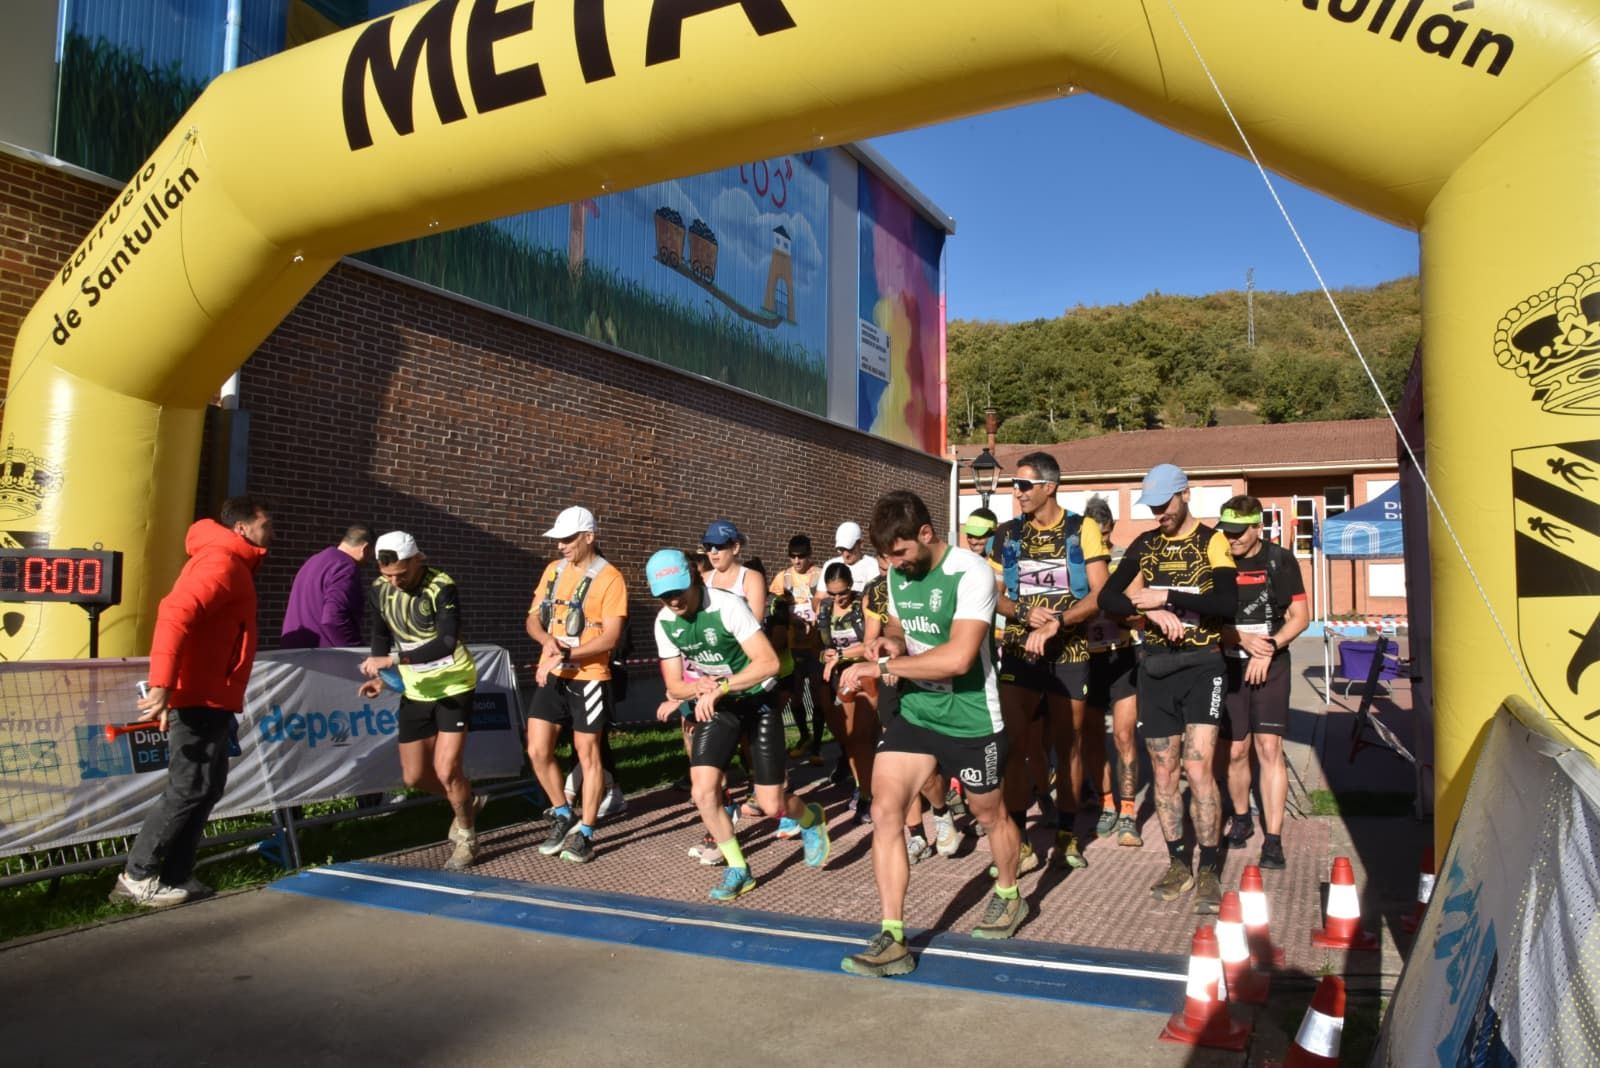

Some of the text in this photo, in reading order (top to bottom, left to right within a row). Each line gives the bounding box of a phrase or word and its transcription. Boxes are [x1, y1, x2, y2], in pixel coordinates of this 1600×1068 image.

[1302, 0, 1515, 77] ullán
[52, 167, 200, 346] de Santullán
[62, 163, 155, 286] Barruelo
[1031, 571, 1056, 586] 14
